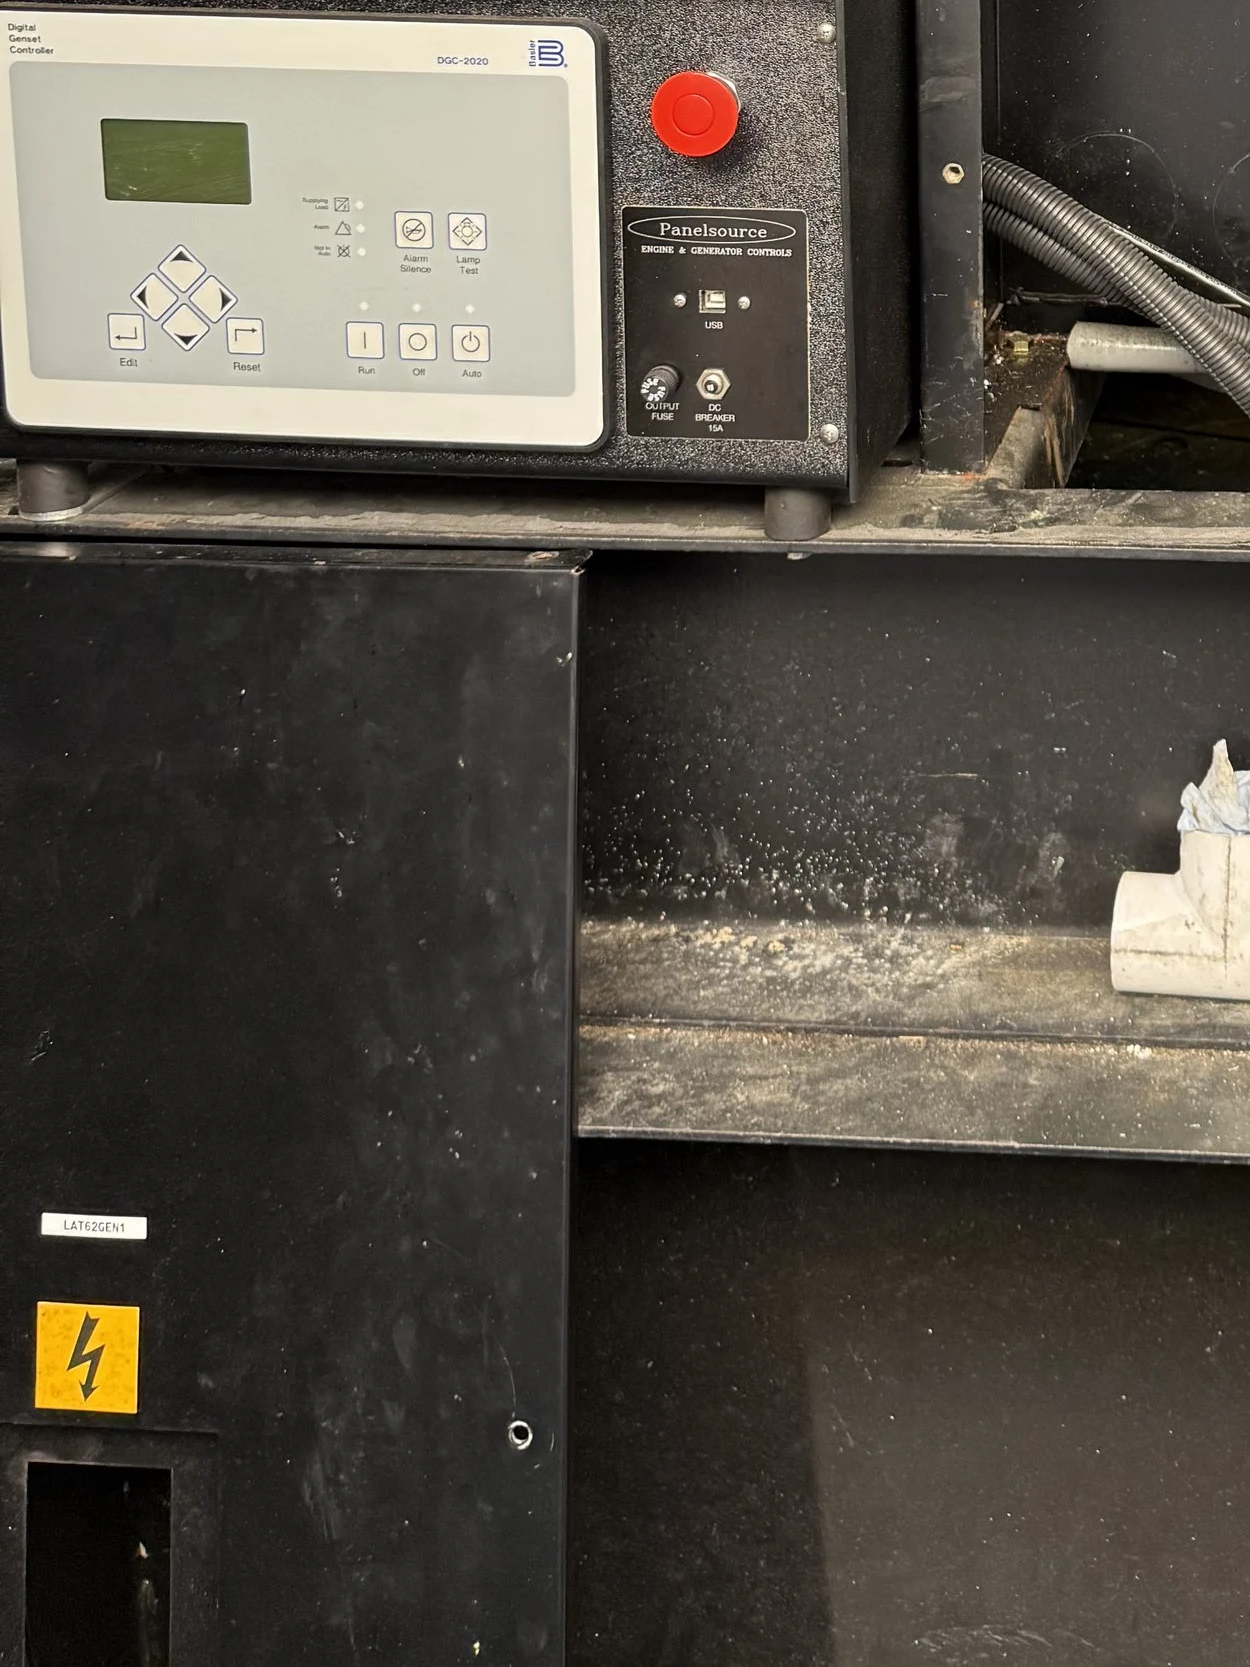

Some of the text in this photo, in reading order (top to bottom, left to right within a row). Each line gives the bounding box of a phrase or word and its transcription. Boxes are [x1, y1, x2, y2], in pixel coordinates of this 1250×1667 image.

[8, 23, 36, 32] Digital
[8, 34, 41, 43] Genset
[9, 45, 54, 54] Controller
[437, 56, 489, 65] DGC-2020
[659, 222, 768, 238] Panelsource
[641, 245, 792, 257] ENGINE & GENERATOR CONTROLS
[403, 254, 429, 262] Alarm
[456, 255, 481, 265] Lamp
[400, 264, 432, 273] Silence
[460, 266, 479, 275] Test
[705, 321, 724, 329] USB
[119, 357, 138, 367] Edit
[233, 362, 261, 372] Reset
[358, 366, 376, 374] Run
[412, 368, 426, 376] Off
[462, 369, 482, 378] Auto
[645, 402, 680, 410] OUTPUT
[651, 413, 674, 421] FUSE
[695, 414, 736, 422] BREAKER
[709, 424, 724, 432] 15A
[63, 1219, 125, 1233] LAT62GEN1
